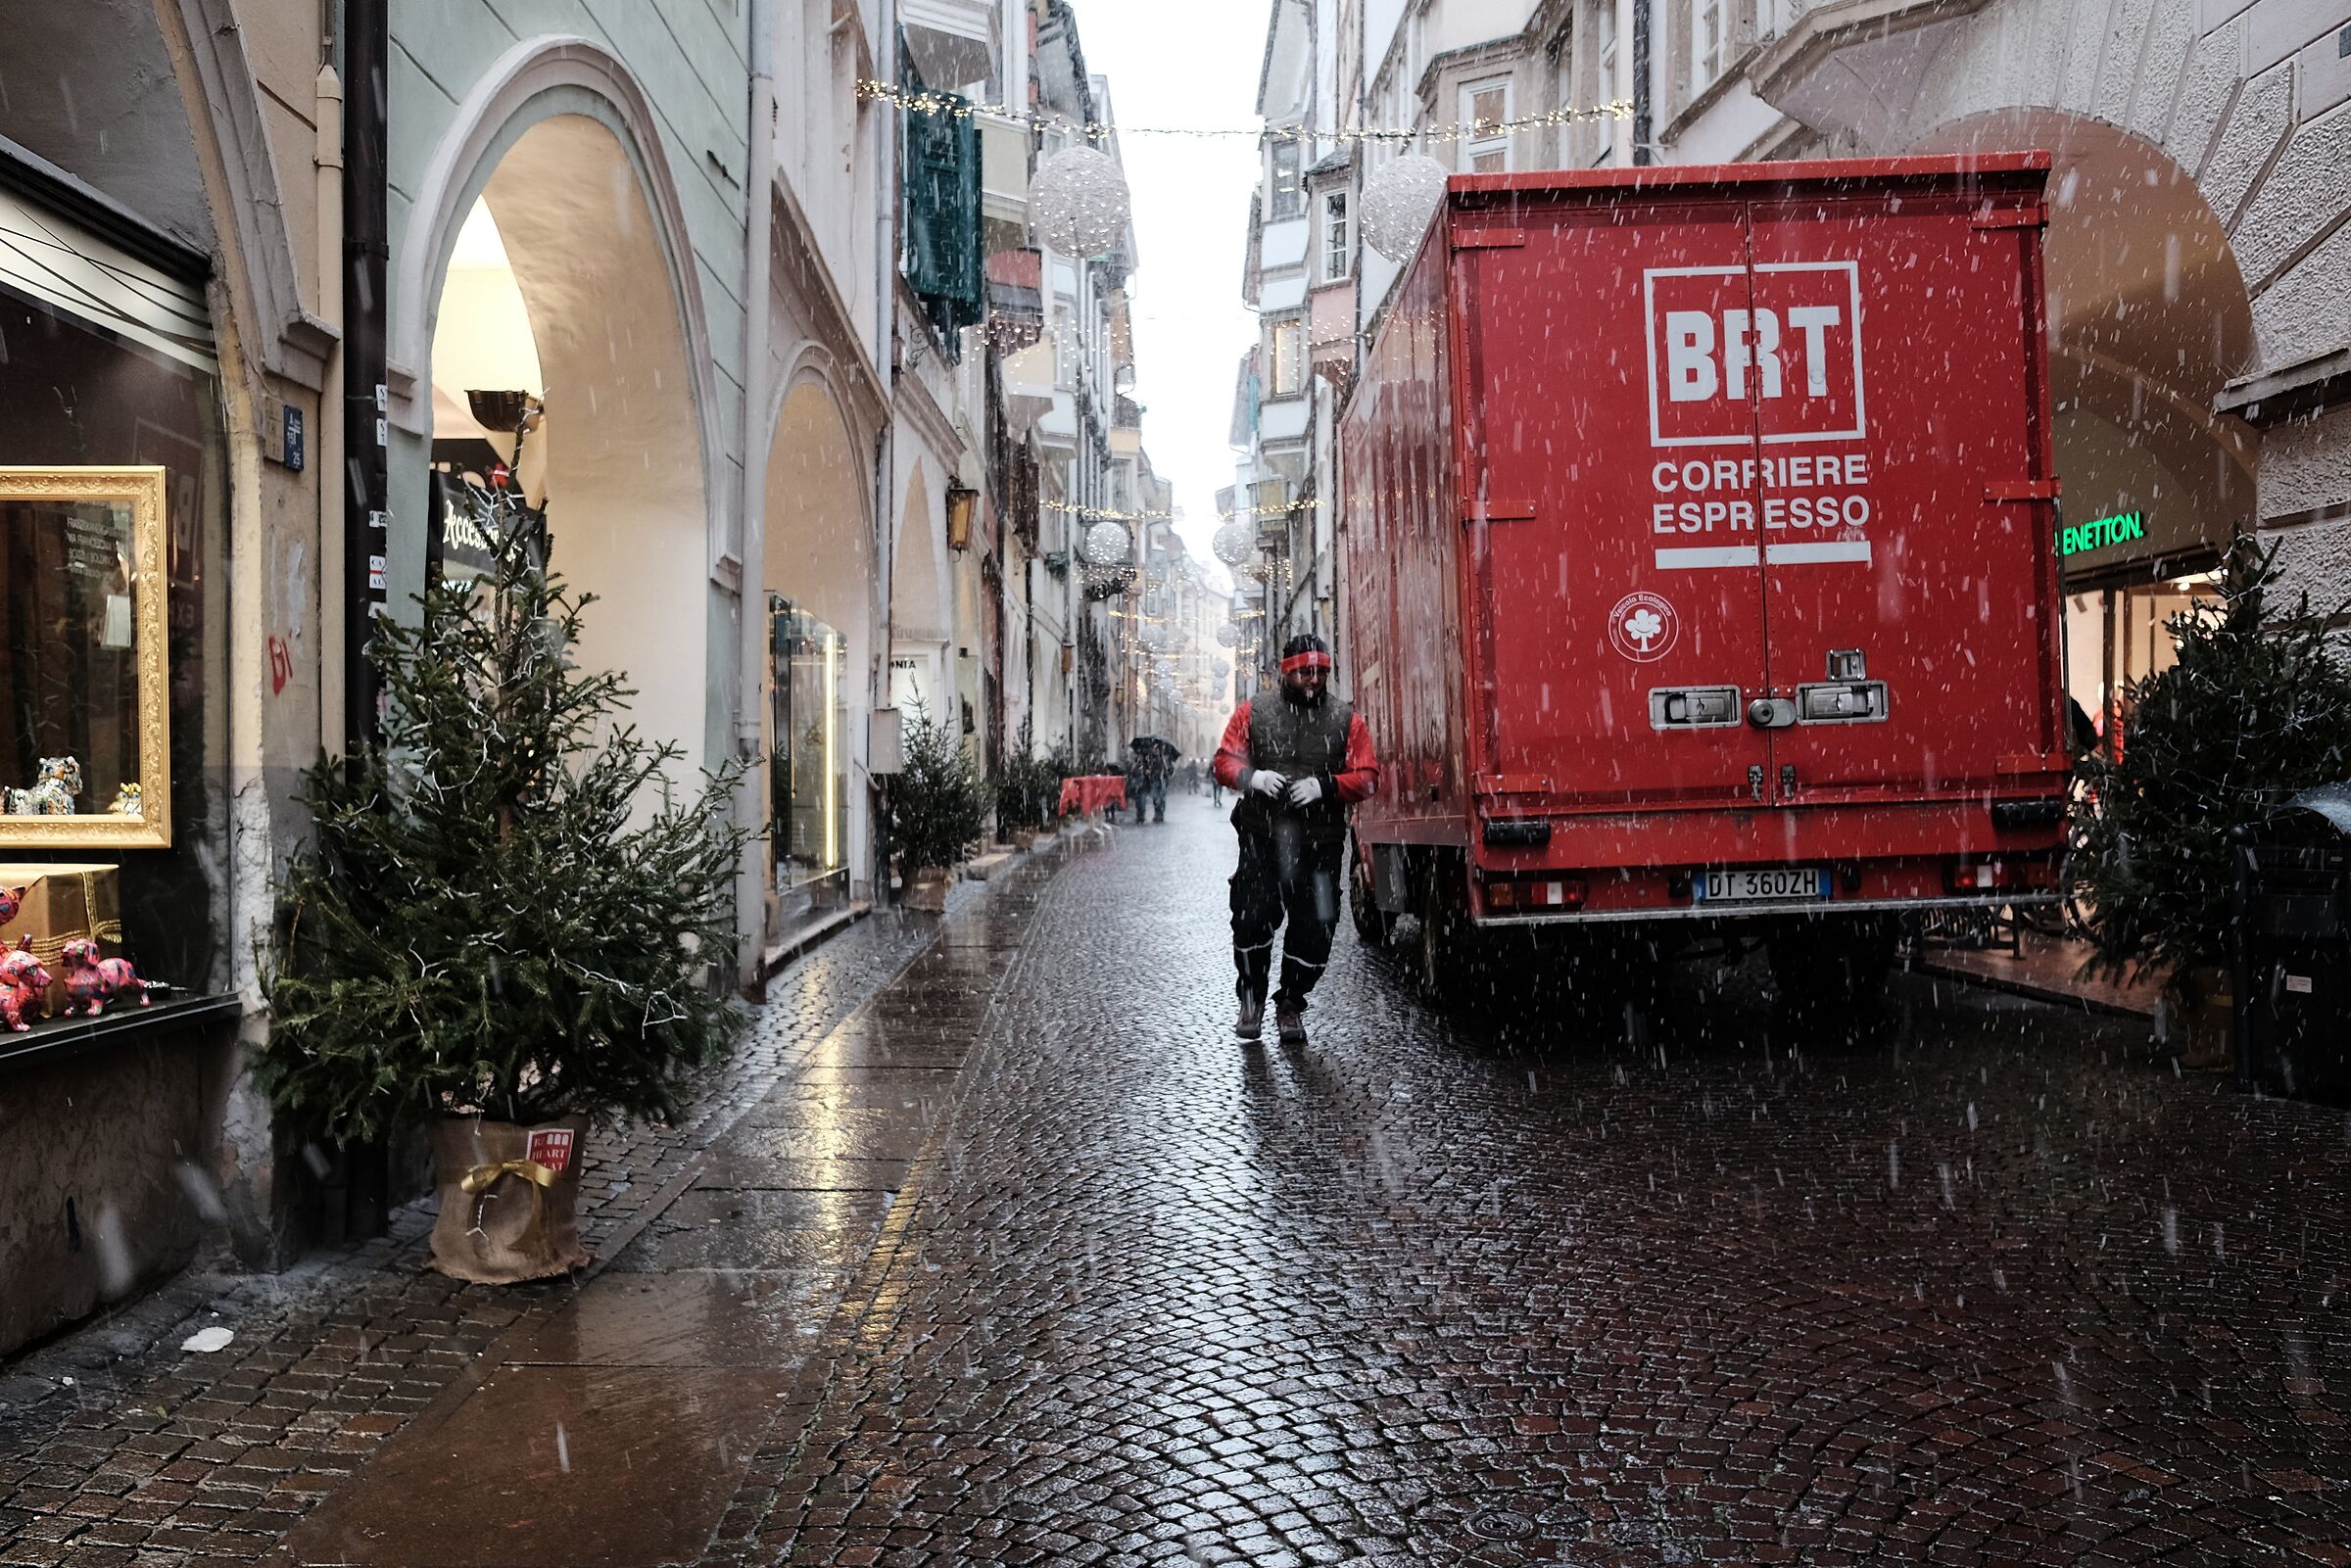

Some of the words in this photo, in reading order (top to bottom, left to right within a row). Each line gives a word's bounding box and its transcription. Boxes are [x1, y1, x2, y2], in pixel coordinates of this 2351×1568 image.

[1666, 306, 1840, 402] BRT
[1652, 454, 1868, 492] CORRIERE
[1654, 495, 1870, 534] ESPRESSO
[2054, 510, 2143, 556] ENETTON.
[1708, 874, 1736, 897] DT
[1746, 871, 1816, 895] 360ZH
